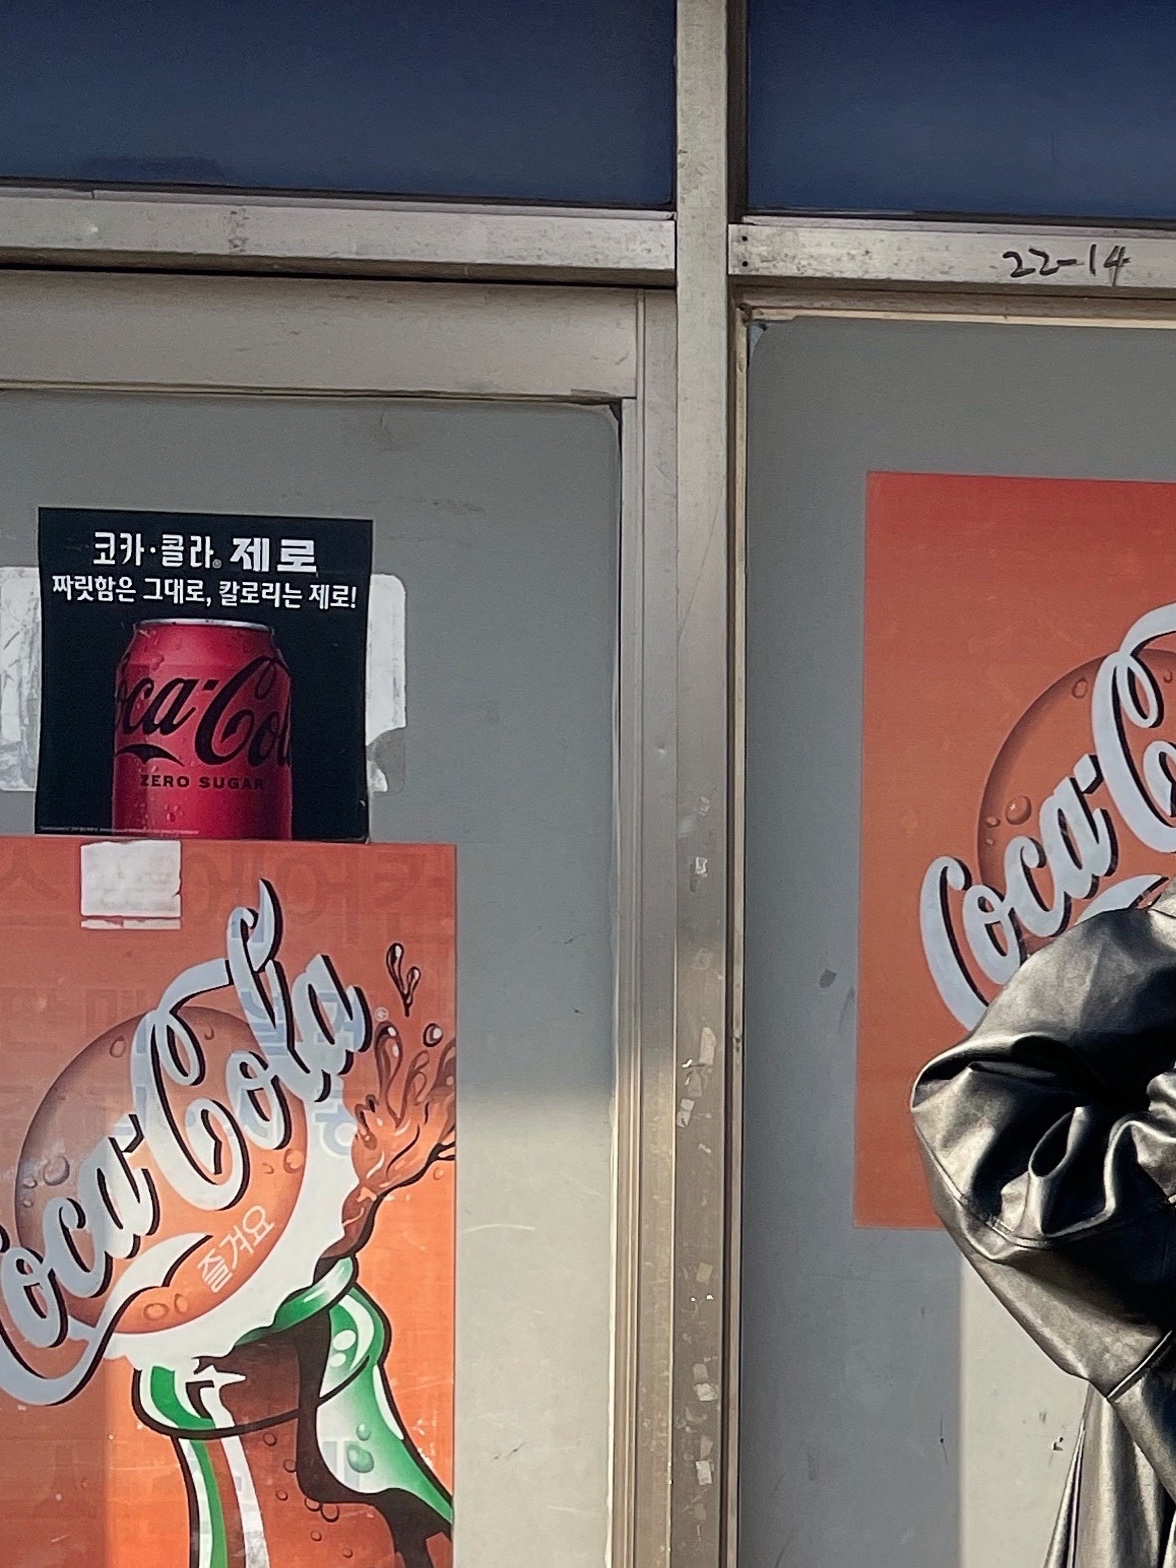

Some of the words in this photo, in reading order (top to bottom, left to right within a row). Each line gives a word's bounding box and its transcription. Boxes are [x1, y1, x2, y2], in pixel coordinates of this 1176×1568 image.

[1002, 243, 1131, 288] 22-14
[230, 537, 317, 573] 제로
[52, 575, 137, 603] 짜릿함은
[143, 577, 211, 607] 그대로,
[218, 580, 303, 609] 칼로리는
[308, 584, 358, 610] 제로!
[139, 774, 190, 788] ZERO
[198, 776, 265, 791] SUGAR
[196, 1205, 275, 1294] 즐겨요
